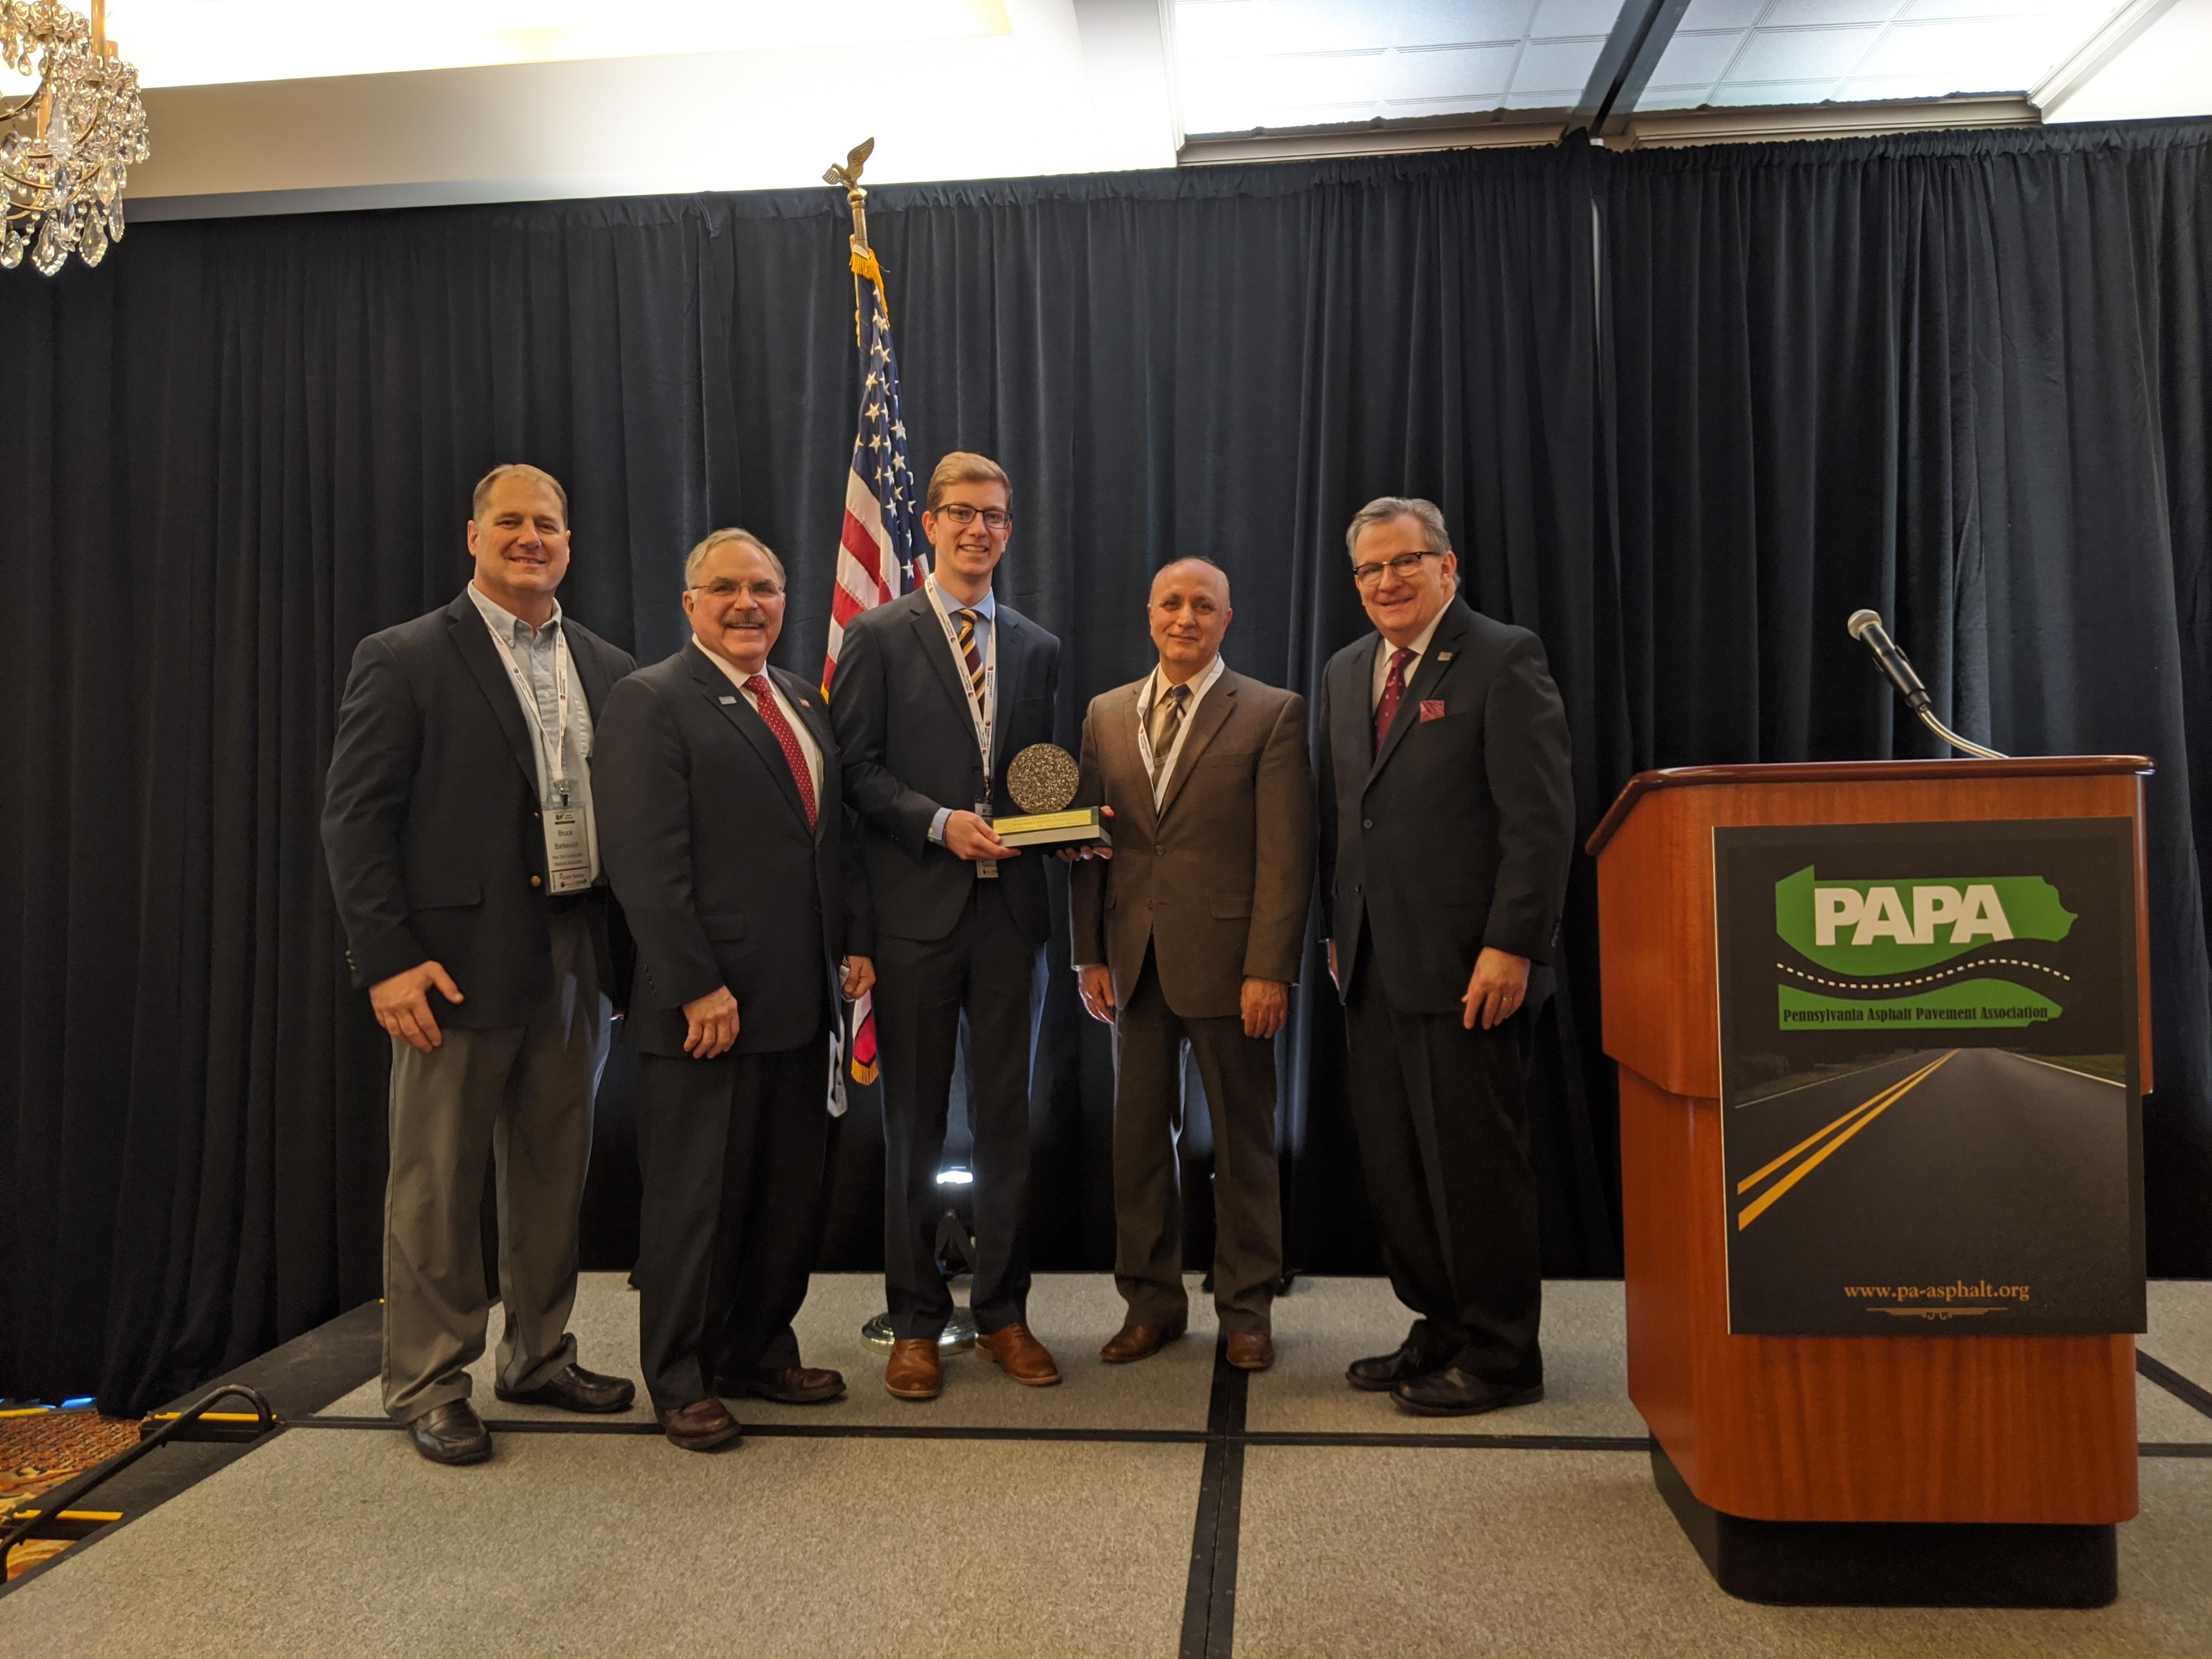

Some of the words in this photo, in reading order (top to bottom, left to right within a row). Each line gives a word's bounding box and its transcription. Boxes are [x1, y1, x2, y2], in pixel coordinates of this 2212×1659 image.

[1814, 884, 2014, 946] PAPA
[1783, 1008, 1864, 1023] Pennsylvania
[1867, 1007, 1911, 1022] Asphalt
[1916, 1007, 1977, 1020] Pavement
[1980, 1006, 2049, 1019] Association
[1844, 1279, 2030, 1303] www.pa-asphalt.org
